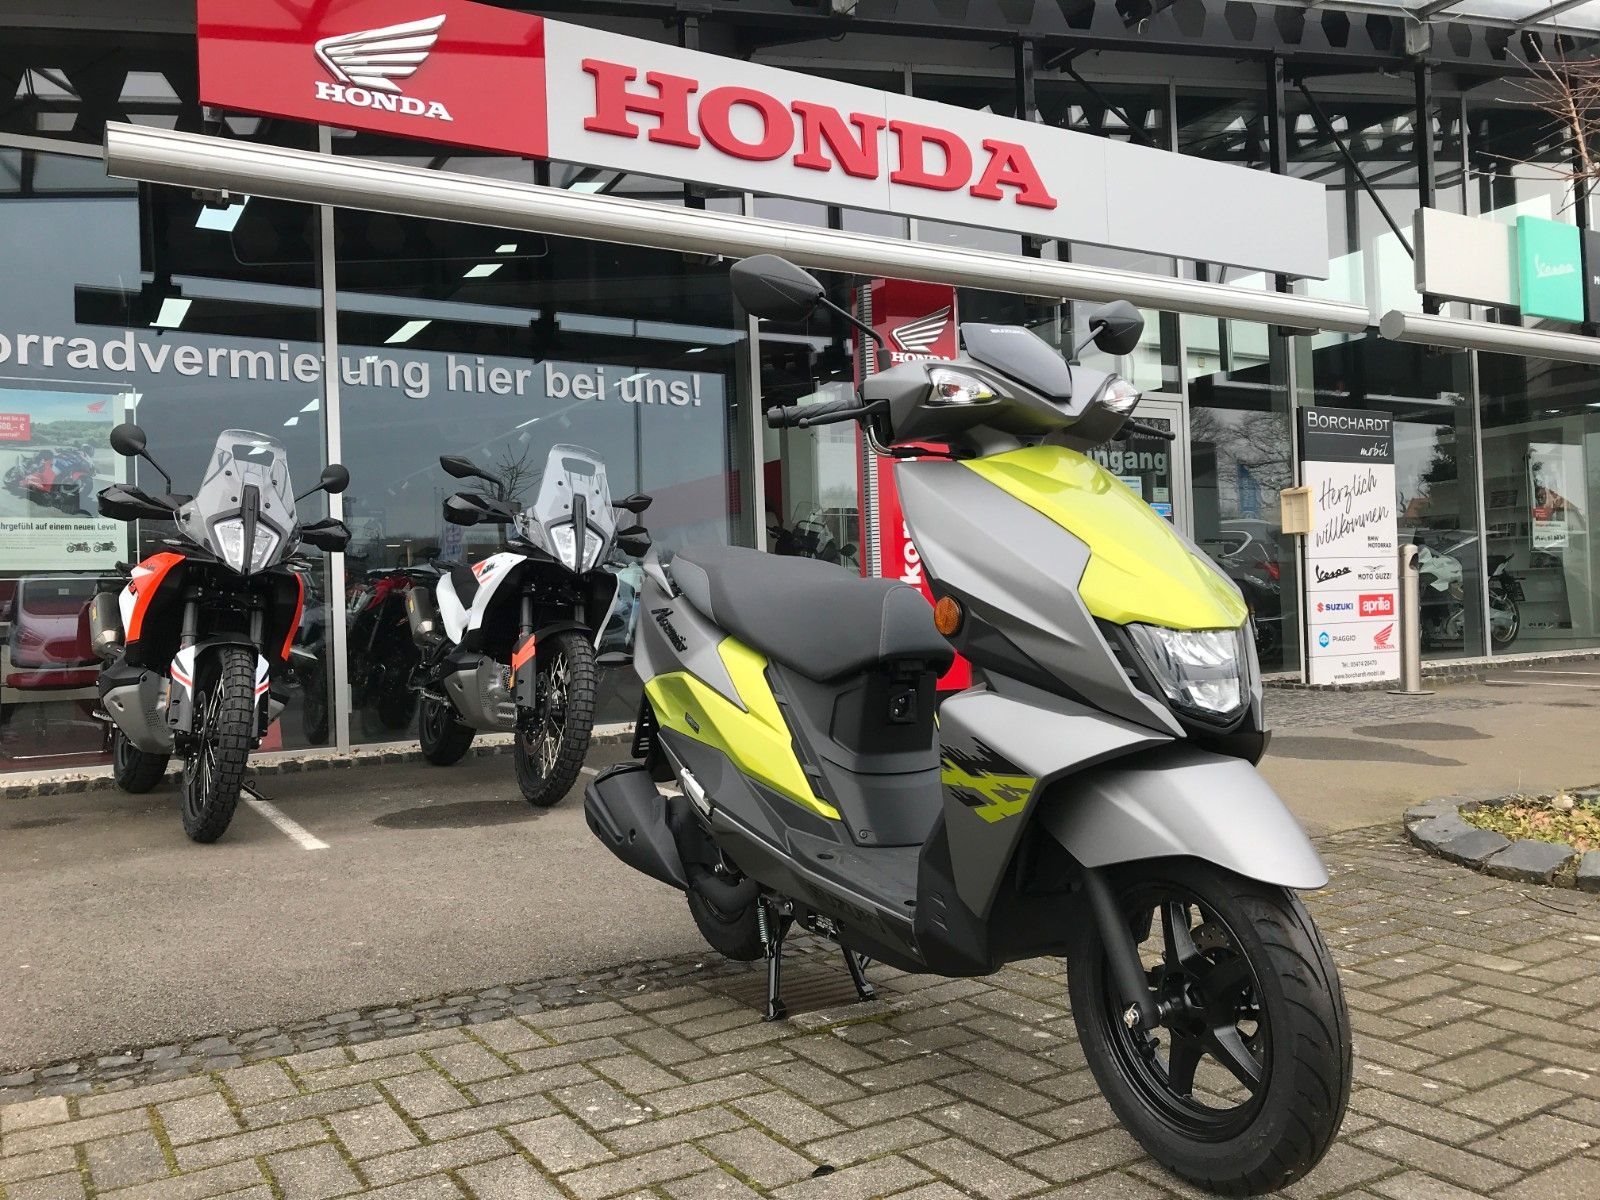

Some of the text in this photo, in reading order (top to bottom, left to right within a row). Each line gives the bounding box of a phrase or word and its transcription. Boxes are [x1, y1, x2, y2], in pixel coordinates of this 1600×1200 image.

[315, 81, 453, 121] HONDA
[582, 58, 1057, 209] HONDA
[0, 331, 702, 406] rradvermieung hier bei uns!
[1360, 442, 1388, 457] mobil
[1319, 468, 1377, 514] Herzlich
[49, 523, 71, 531] einem
[73, 523, 95, 531] neuen
[97, 523, 117, 531] Level
[1316, 506, 1389, 547] willkommen
[1315, 564, 1352, 584] Vespa
[1325, 603, 1353, 611] SUZUKI
[1362, 596, 1391, 614] aprilia
